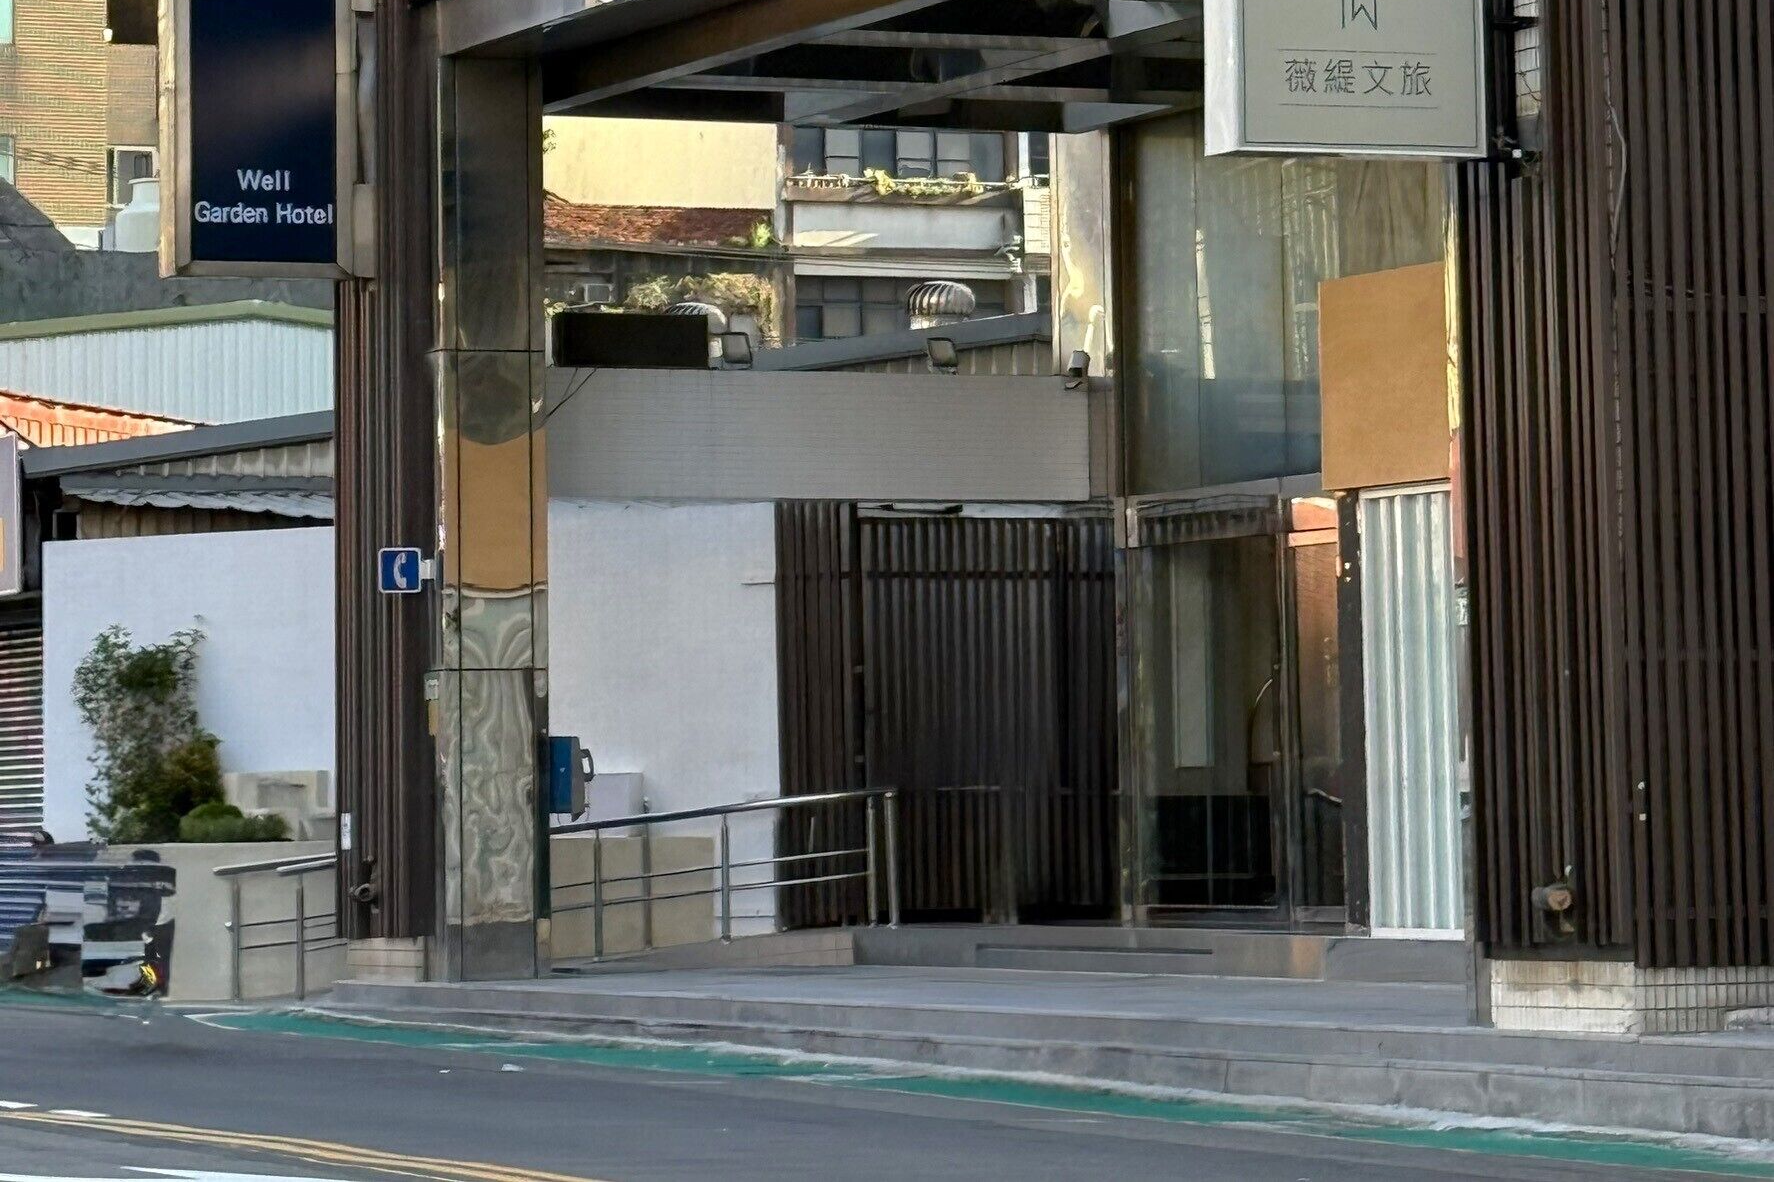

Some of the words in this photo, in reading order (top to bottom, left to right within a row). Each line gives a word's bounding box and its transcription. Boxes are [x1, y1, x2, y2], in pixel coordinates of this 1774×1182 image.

[1284, 58, 1432, 96] 薇緹文旅
[236, 168, 291, 191] Well
[194, 200, 269, 224] Garden
[275, 202, 333, 225] Hotel
